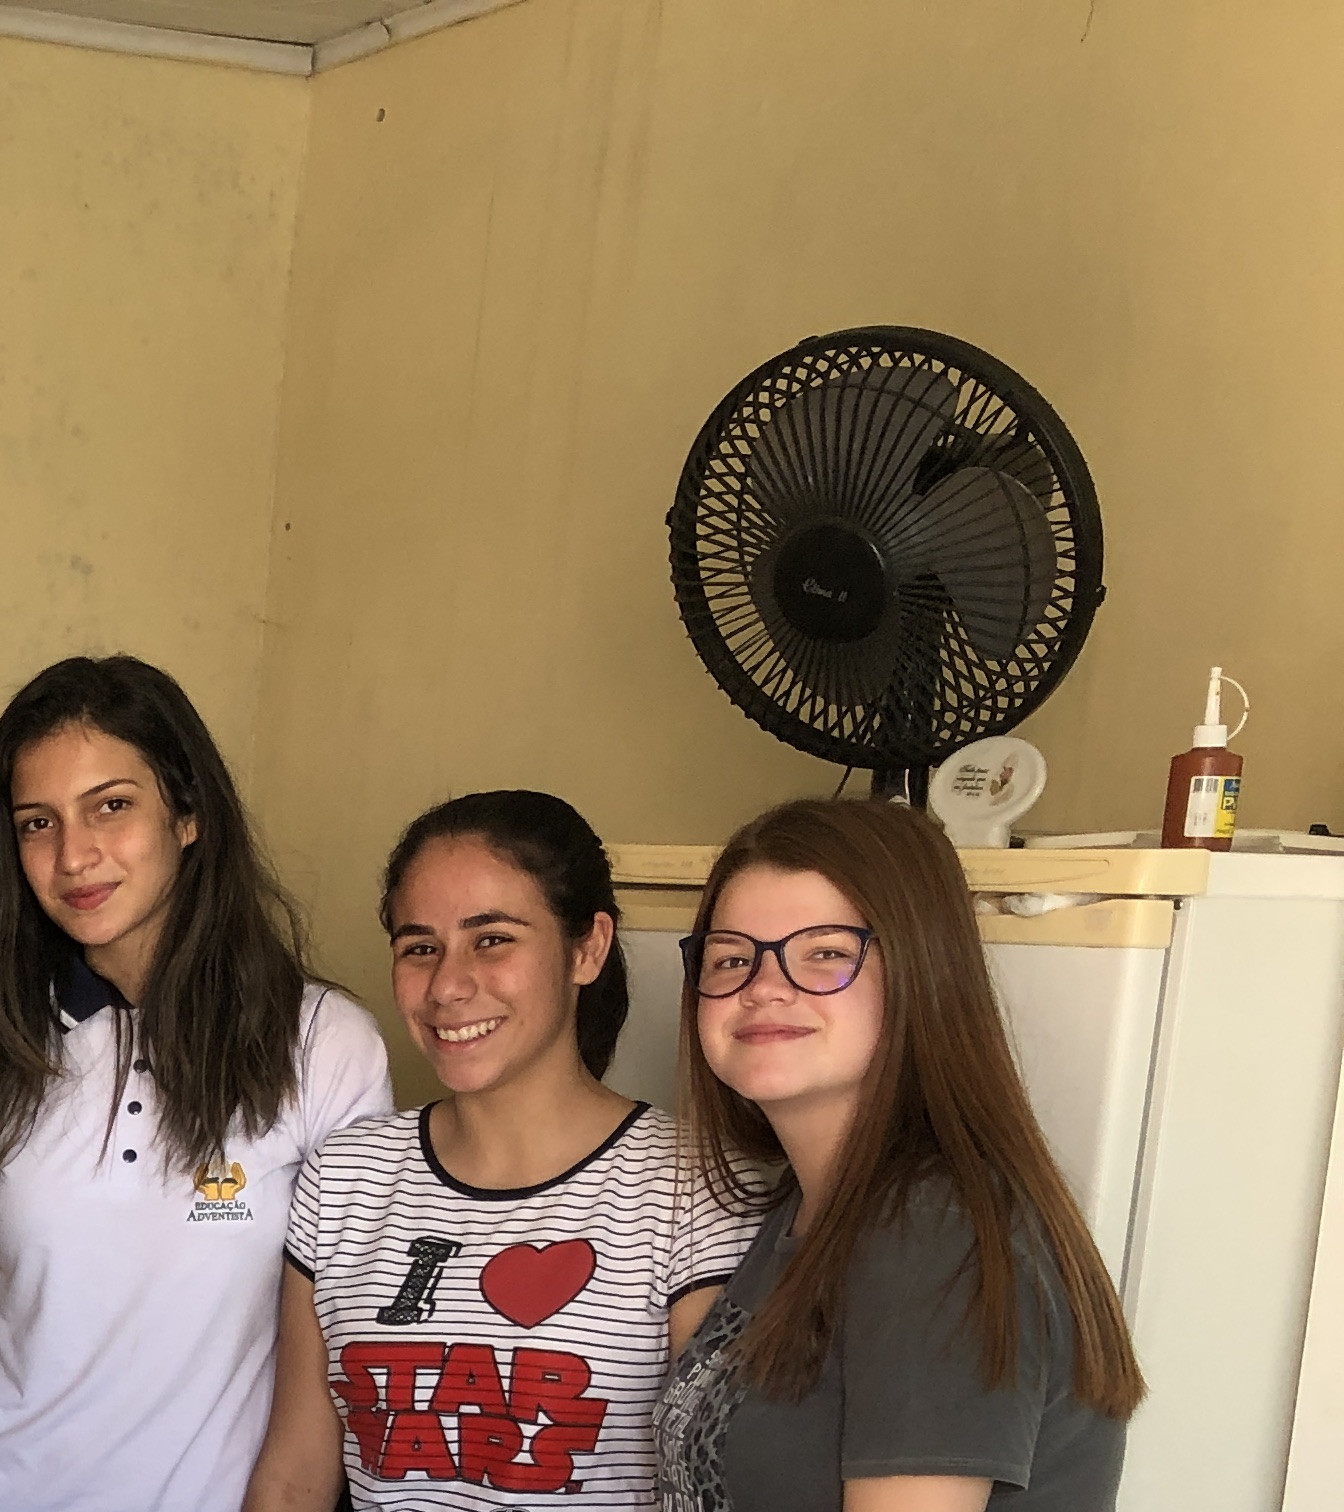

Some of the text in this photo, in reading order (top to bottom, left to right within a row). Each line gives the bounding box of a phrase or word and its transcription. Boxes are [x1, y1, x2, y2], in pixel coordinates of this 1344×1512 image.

[186, 1208, 254, 1222] ADVENTISTA
[195, 1200, 246, 1211] EDUCAÇÃO
[376, 1235, 463, 1326] I
[329, 1341, 610, 1428] STAR
